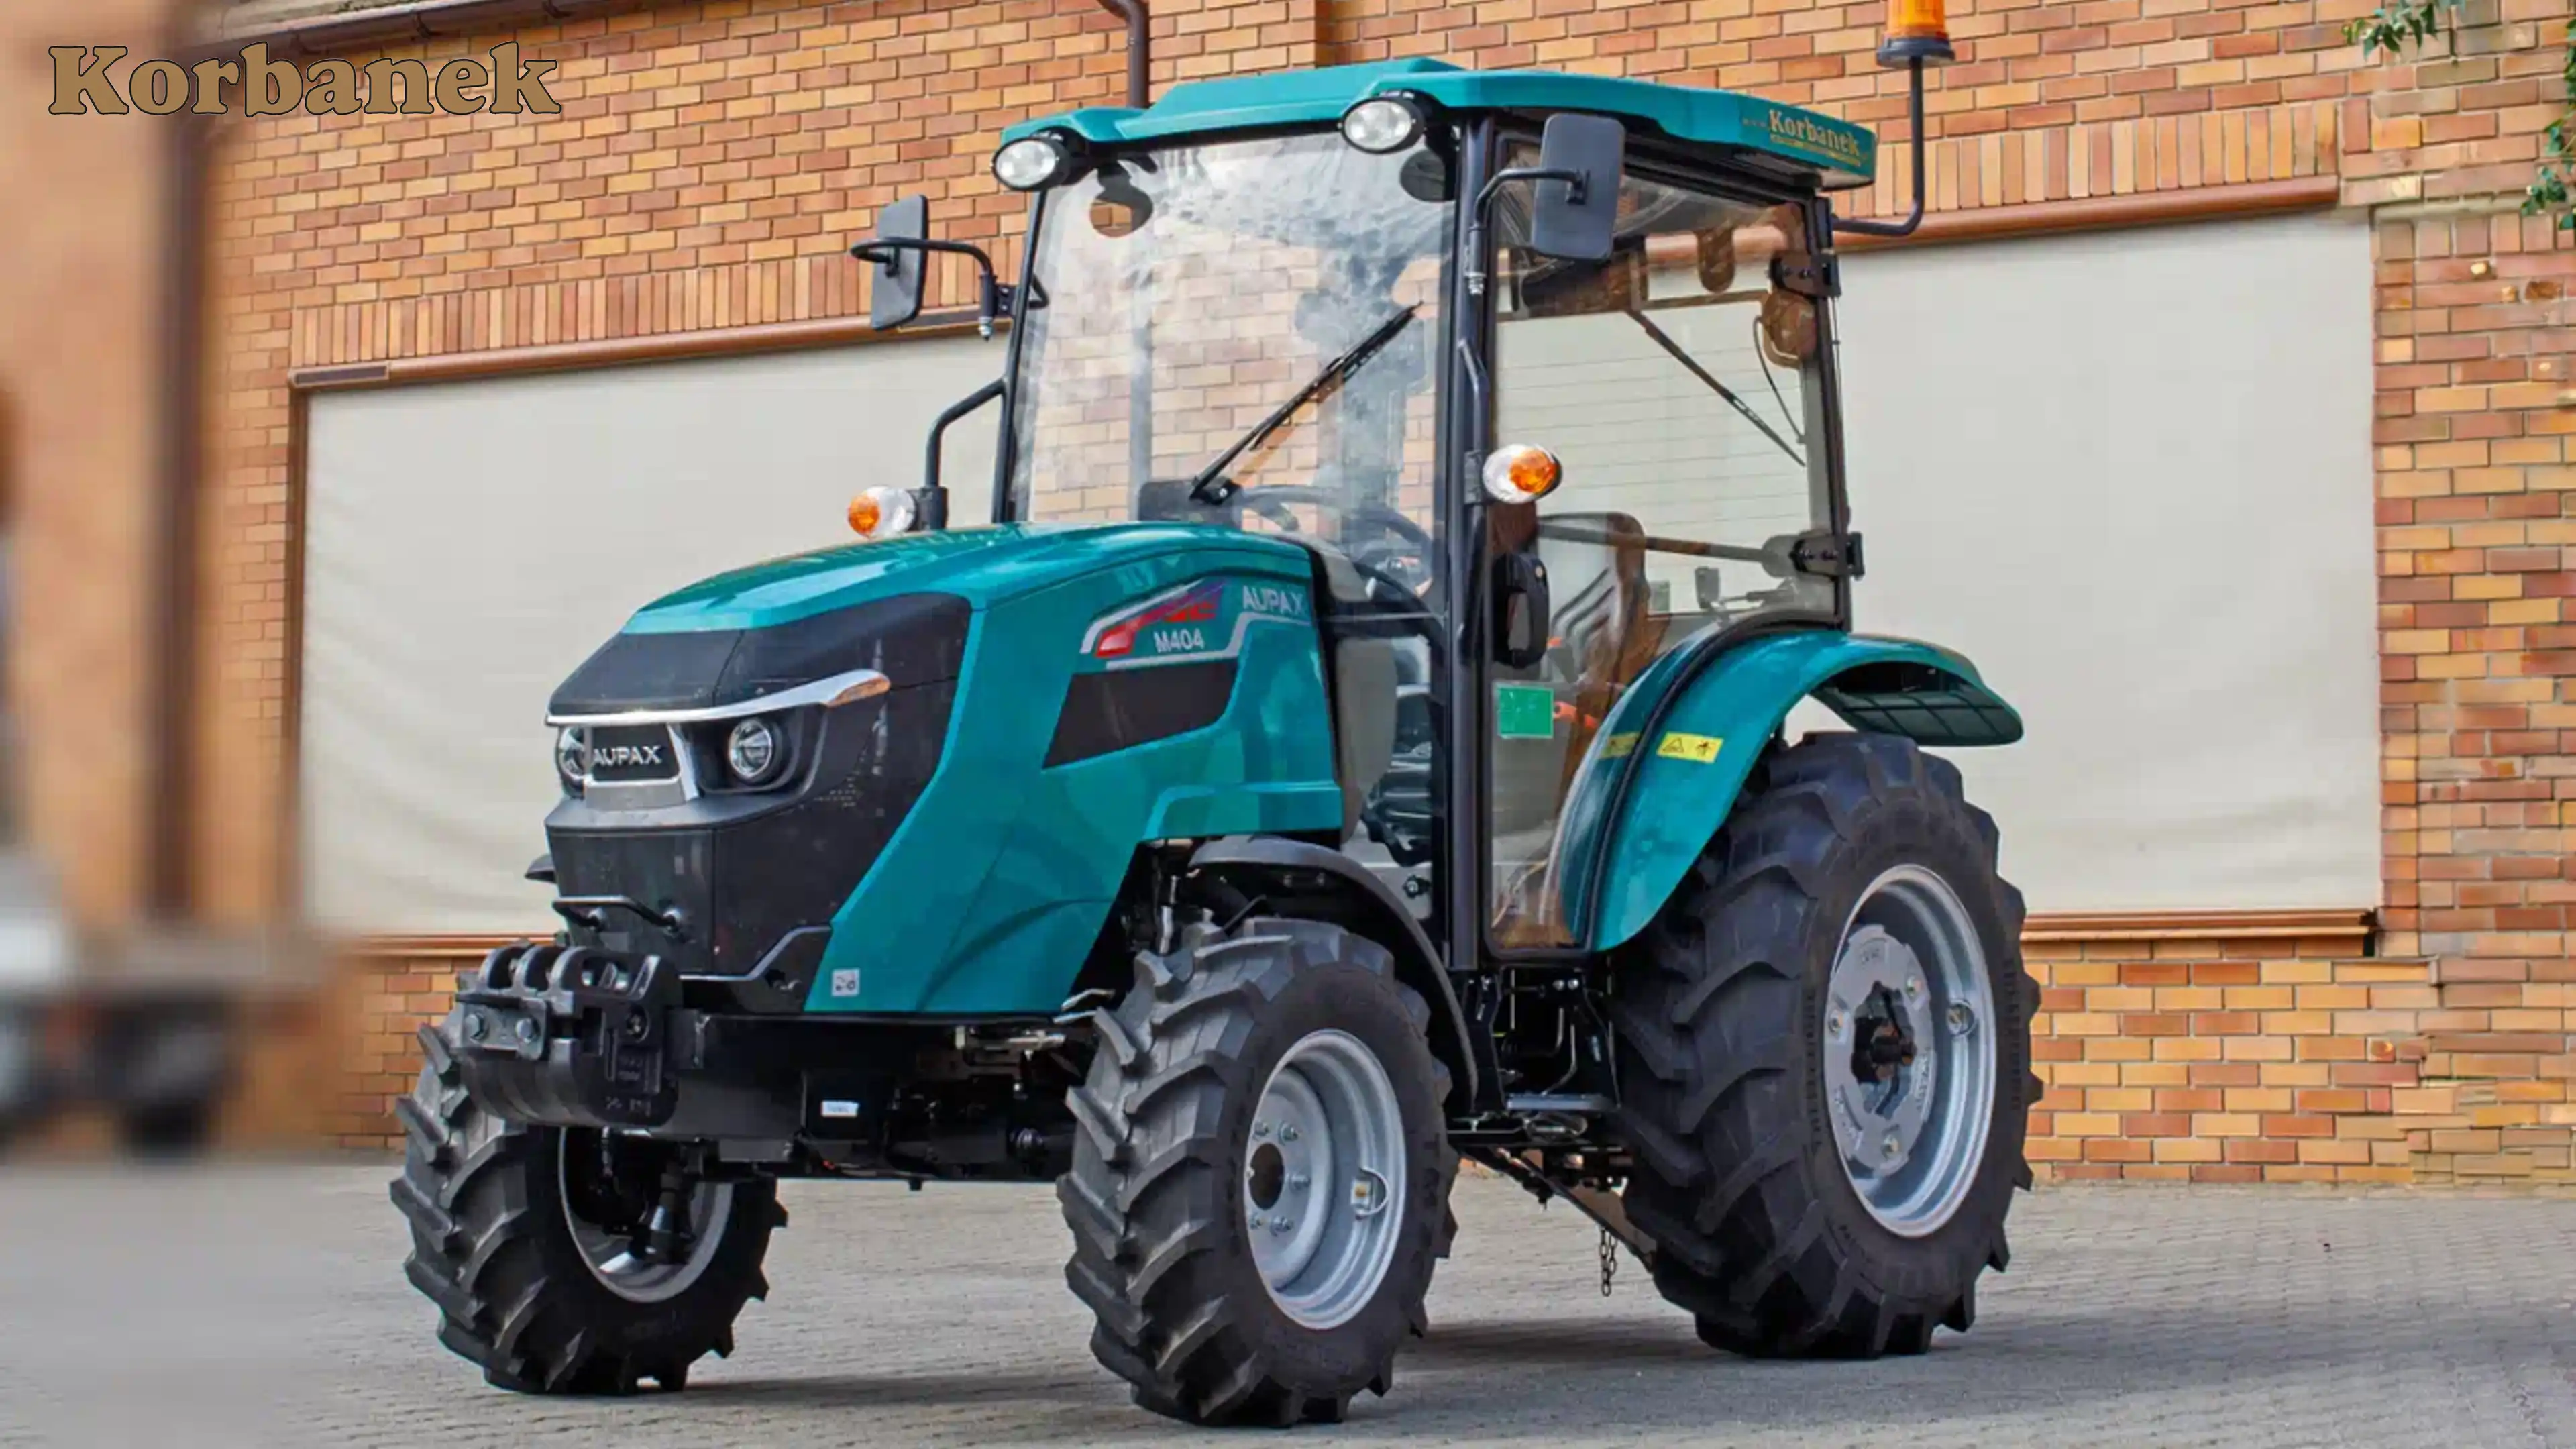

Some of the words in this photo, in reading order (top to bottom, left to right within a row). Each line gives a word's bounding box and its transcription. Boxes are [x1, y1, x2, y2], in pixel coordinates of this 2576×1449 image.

[1769, 109, 1859, 156] Korbanek
[1242, 585, 1305, 615] AUPAX
[1154, 629, 1205, 653] M404
[592, 745, 661, 767] AUPAX
